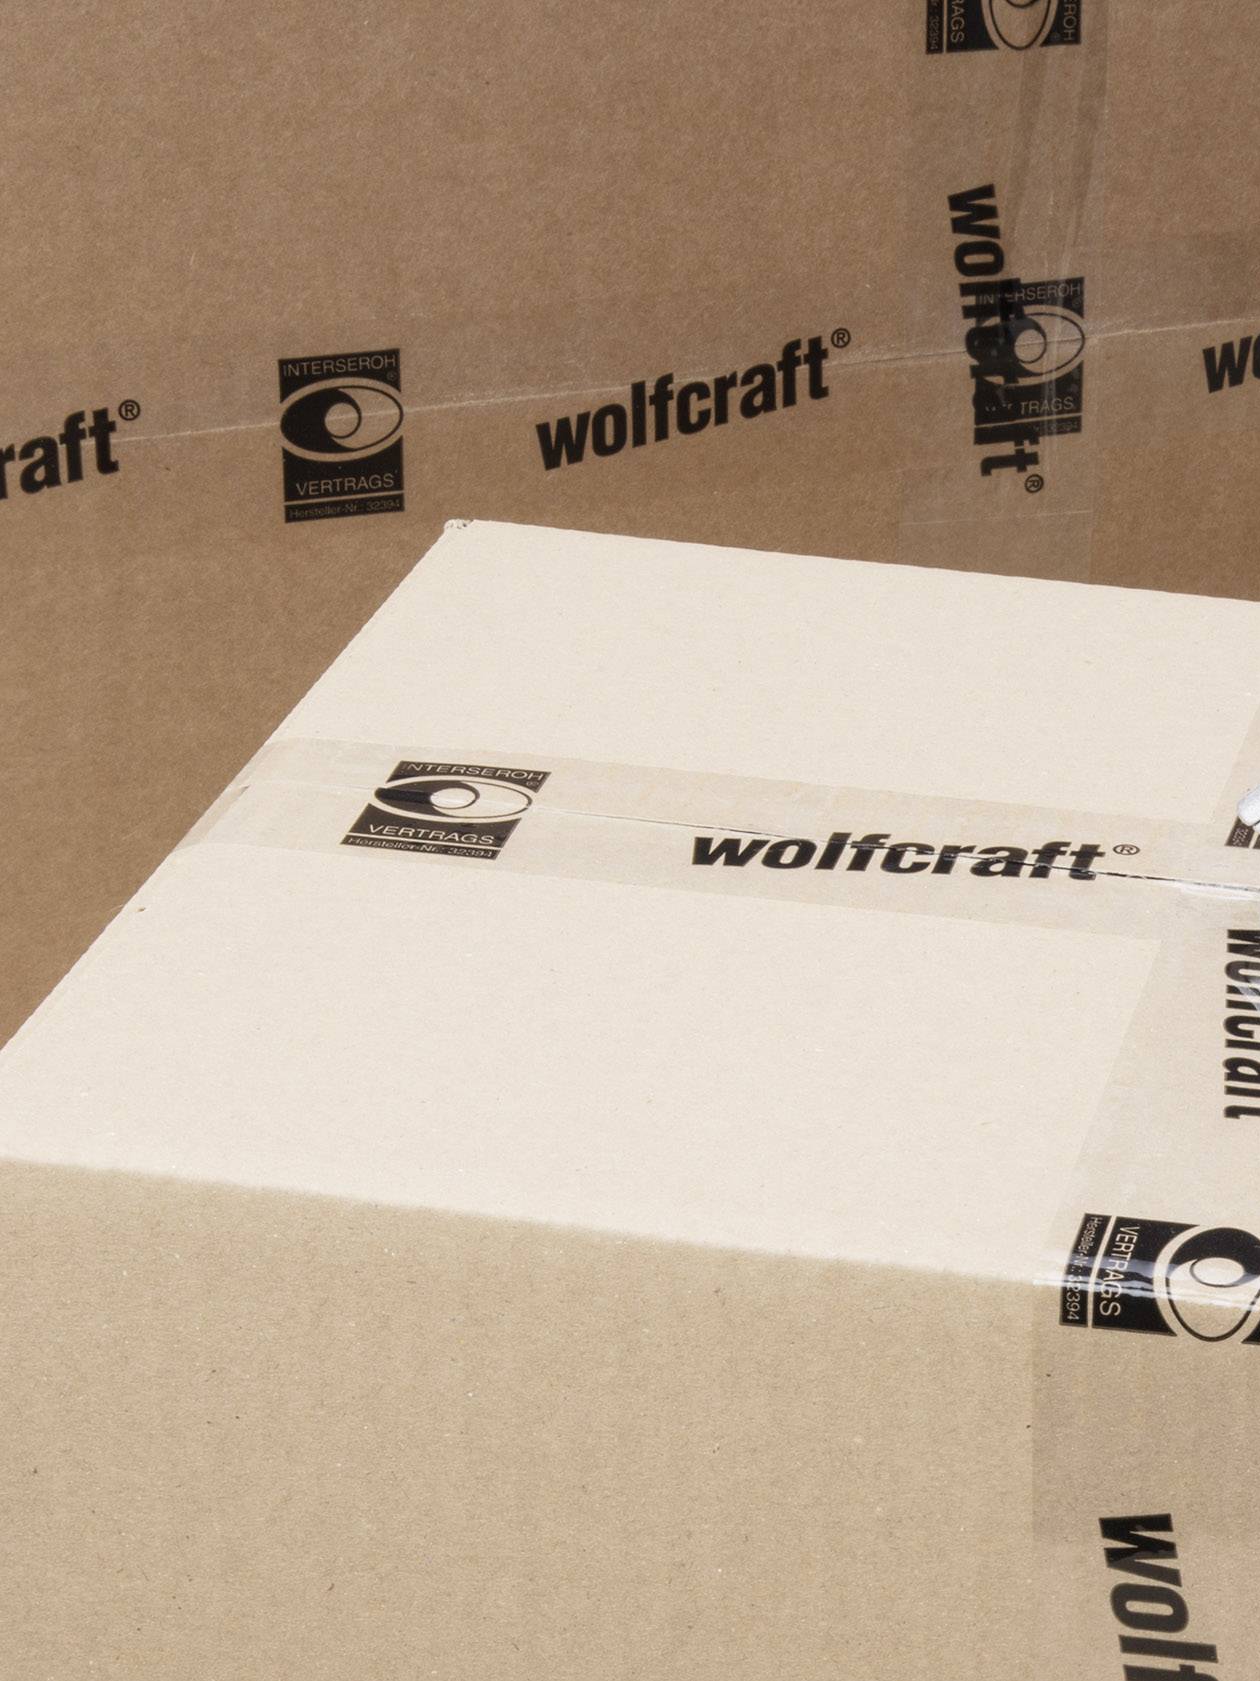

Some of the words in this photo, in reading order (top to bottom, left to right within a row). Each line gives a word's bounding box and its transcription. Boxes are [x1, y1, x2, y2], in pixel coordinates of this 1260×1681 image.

[283, 354, 396, 377] INTERSEROH
[296, 472, 395, 497] VERTRAGS
[401, 762, 545, 781] INTERSEROH
[368, 823, 495, 845] VERTRAGS
[1100, 1225, 1141, 1317] VERTRAGS
